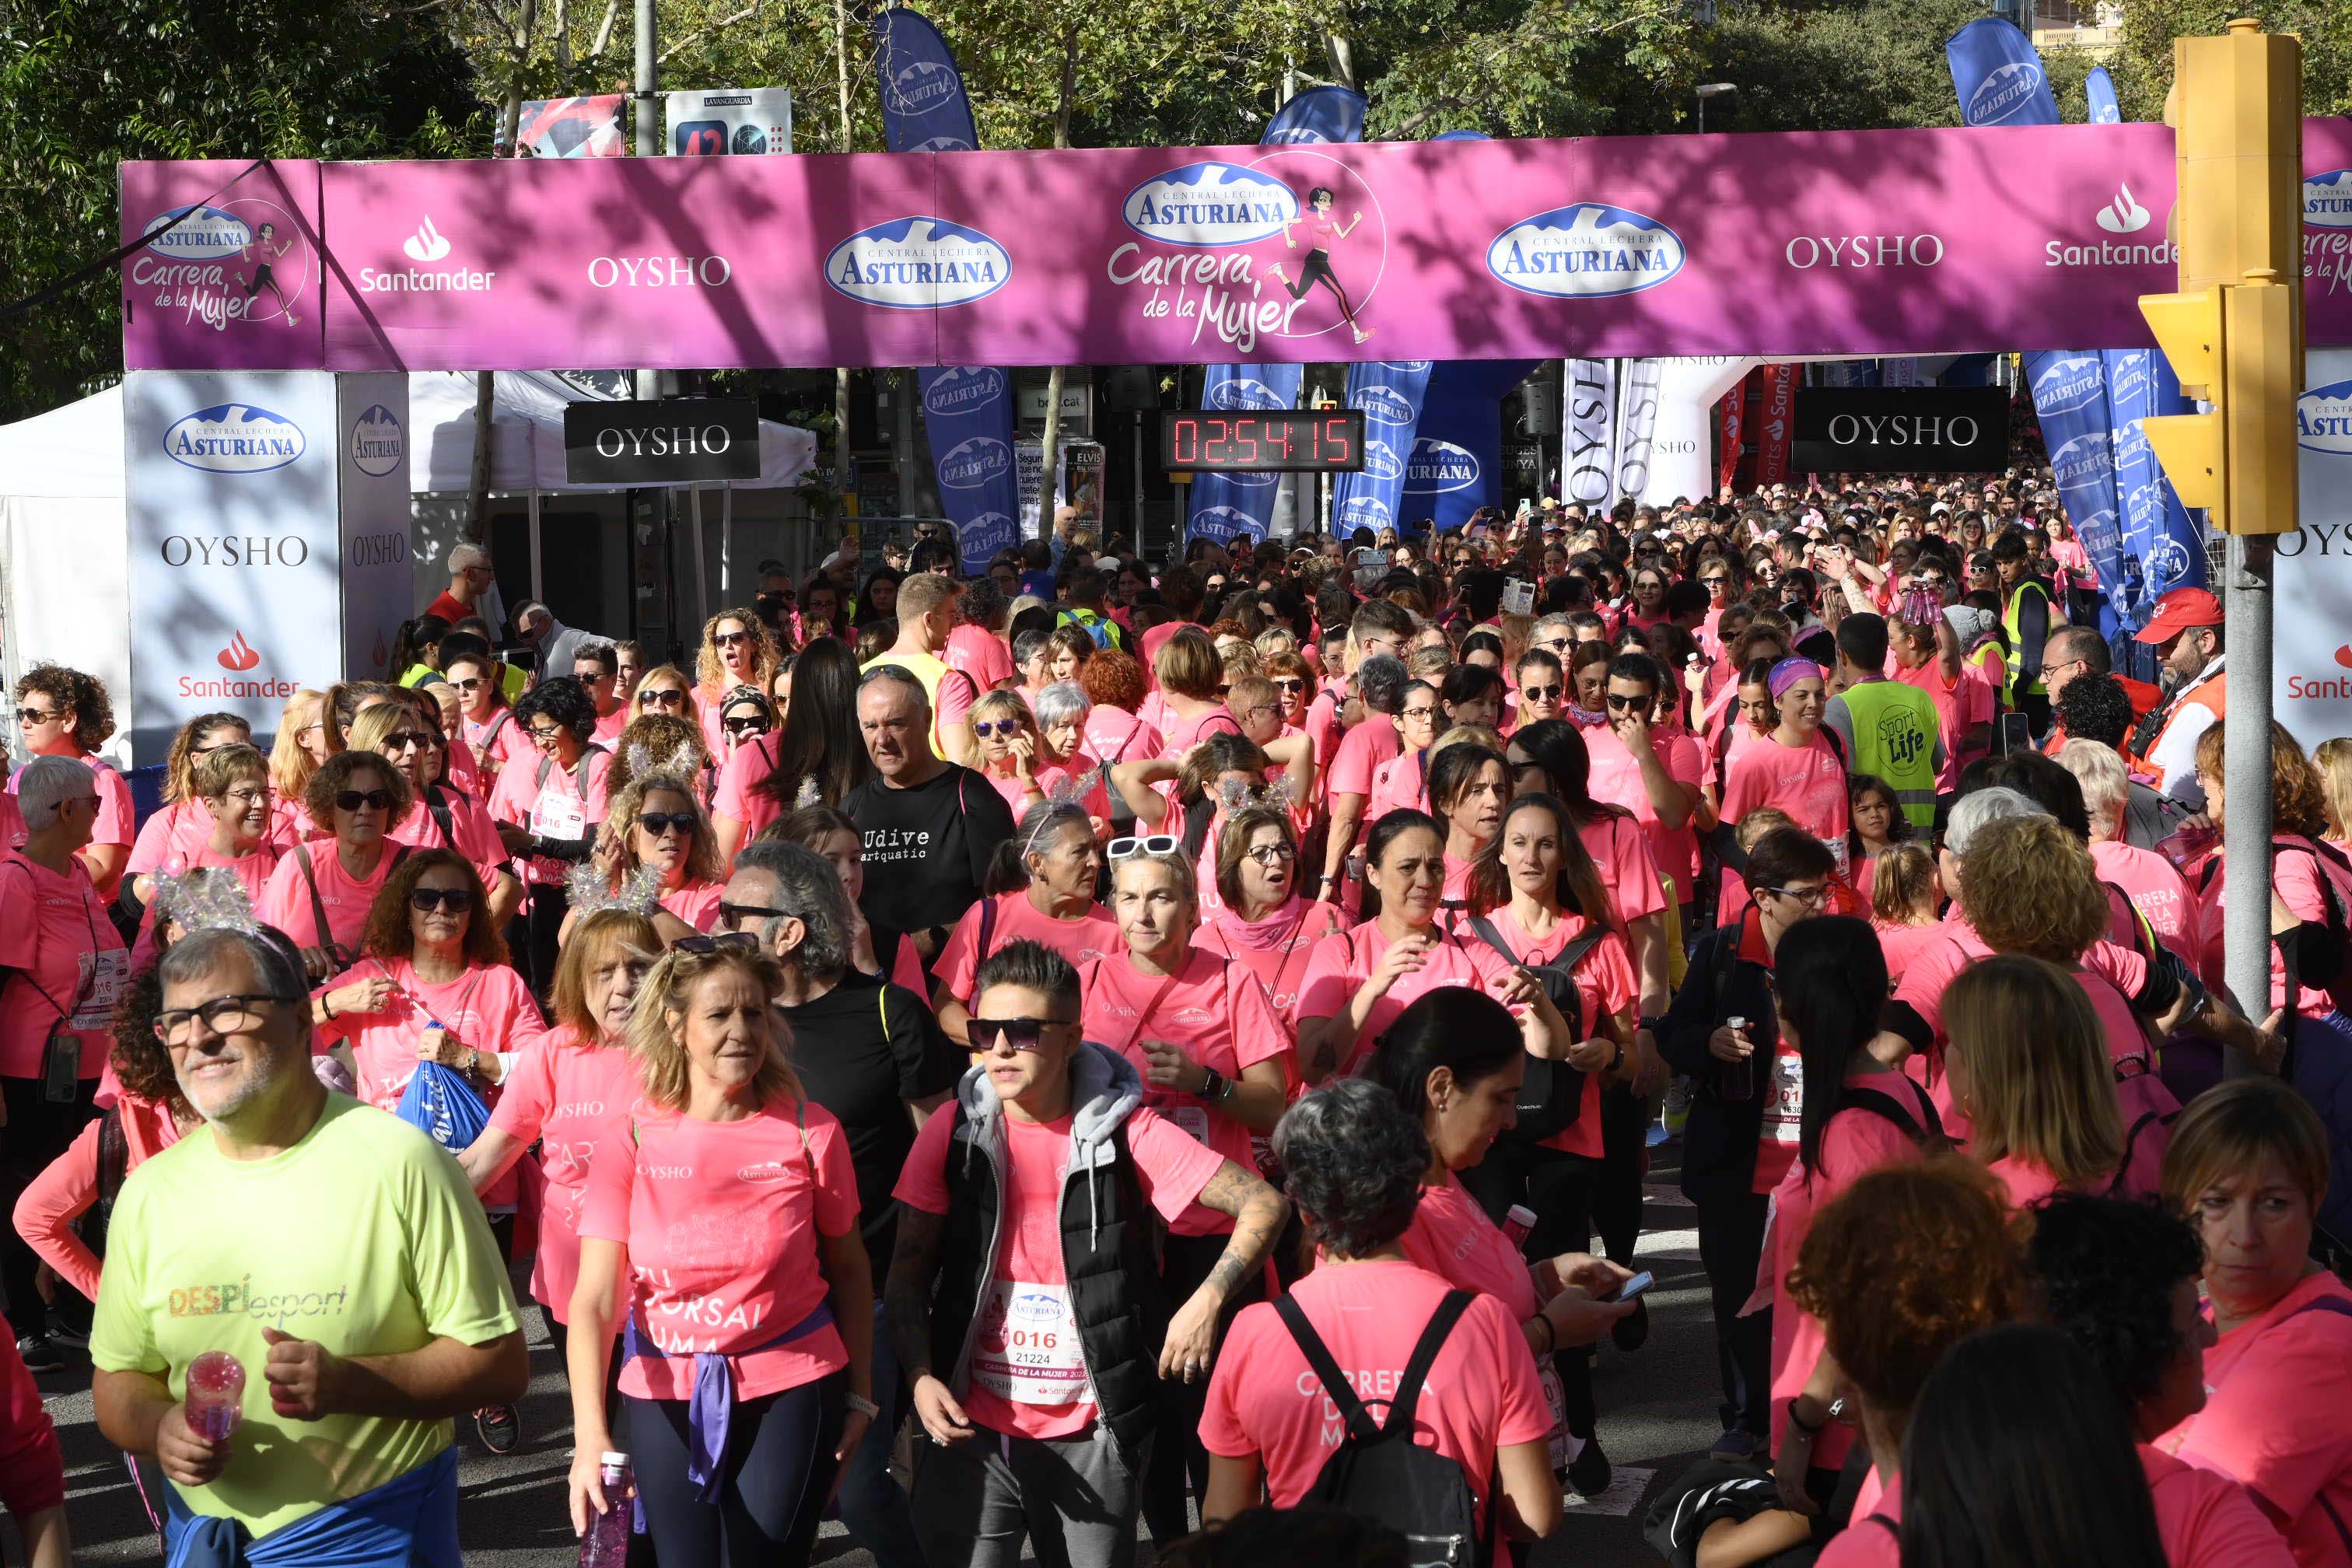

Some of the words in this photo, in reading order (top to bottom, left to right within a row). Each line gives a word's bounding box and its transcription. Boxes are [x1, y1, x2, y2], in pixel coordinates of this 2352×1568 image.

[1136, 194, 1284, 226] ASTURIANA
[1162, 191, 1218, 201] CENTRAL
[867, 248, 926, 258] CENTRAL
[932, 247, 991, 257] LECHERA
[1532, 235, 1594, 247] CENTRAL
[1599, 233, 1663, 245] LECHERA
[1786, 234, 1944, 269] OYSHO
[2046, 240, 2178, 267] Santande
[838, 251, 998, 285] ASTURIANA
[1107, 242, 1253, 285] Carrera
[1502, 240, 1670, 275] ASTURIANA
[2318, 254, 2332, 278] la
[132, 257, 224, 287] Carrera
[360, 268, 495, 292] Santander
[587, 255, 731, 289] OYSHO
[156, 286, 172, 307] de
[176, 285, 188, 307] la
[185, 282, 258, 332] Mujer
[1143, 287, 1170, 318] de
[1175, 286, 1195, 317] la
[1191, 279, 1307, 353] Mujer
[175, 429, 296, 457] ASTURIANA
[596, 425, 731, 458] OYSHO
[1175, 419, 1348, 463] 02:54:15
[1570, 358, 1609, 506] OYSH
[1828, 414, 1979, 447] OYSHO
[355, 432, 401, 460] ASTURIANA
[1076, 453, 1101, 463] ELVIS
[161, 535, 309, 567] OYSHO
[353, 532, 404, 568] OYSHO
[2273, 523, 2352, 557] OYS
[179, 675, 300, 699] Santander
[2288, 676, 2352, 699] Sant
[1879, 710, 1916, 740] Sport
[1888, 728, 1923, 764] Life
[1780, 771, 1807, 787] OYSHO
[864, 828, 930, 849] Udive
[860, 848, 927, 863] artquatic
[2155, 907, 2173, 922] LA
[1780, 1090, 1799, 1102] 01
[637, 1164, 693, 1179] OYSHO
[1013, 1303, 1062, 1316] ASTURIANA
[1013, 1330, 1058, 1349] 016
[985, 1363, 1017, 1374] CARRERA
[1016, 1352, 1051, 1365] 21224
